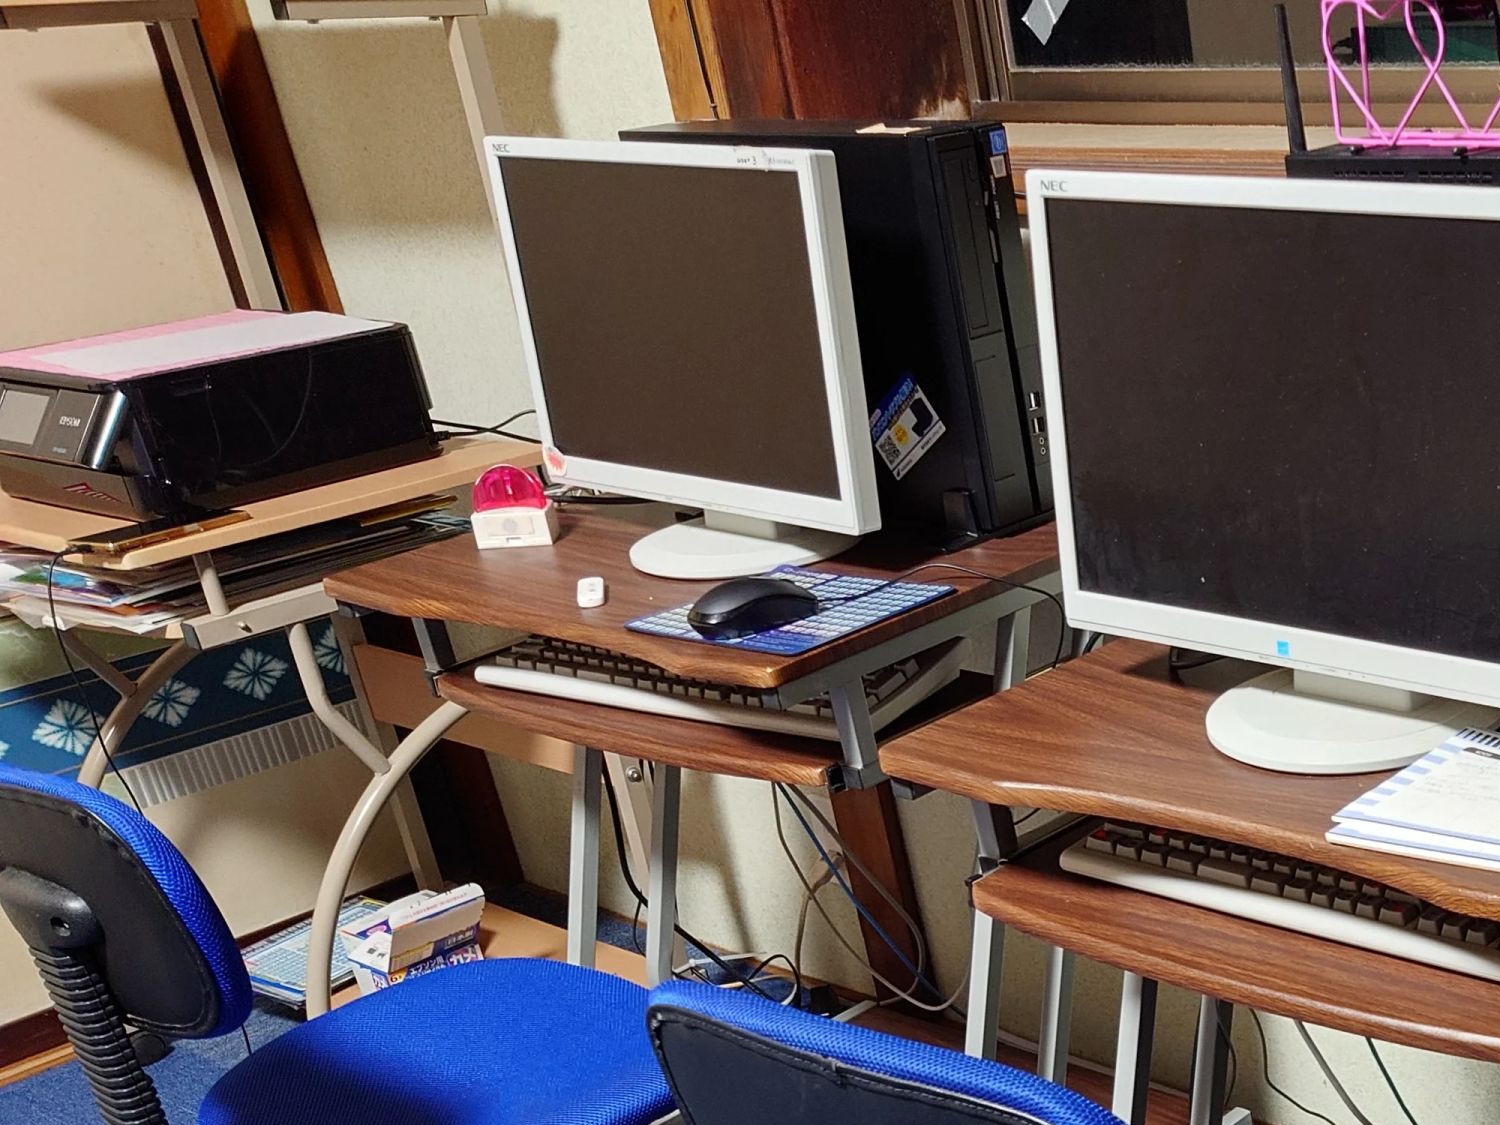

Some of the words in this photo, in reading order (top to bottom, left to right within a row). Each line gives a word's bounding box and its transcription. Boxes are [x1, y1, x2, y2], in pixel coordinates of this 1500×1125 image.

[492, 144, 511, 153] NEC
[1040, 180, 1069, 192] NEC
[59, 416, 80, 427] EPSON
